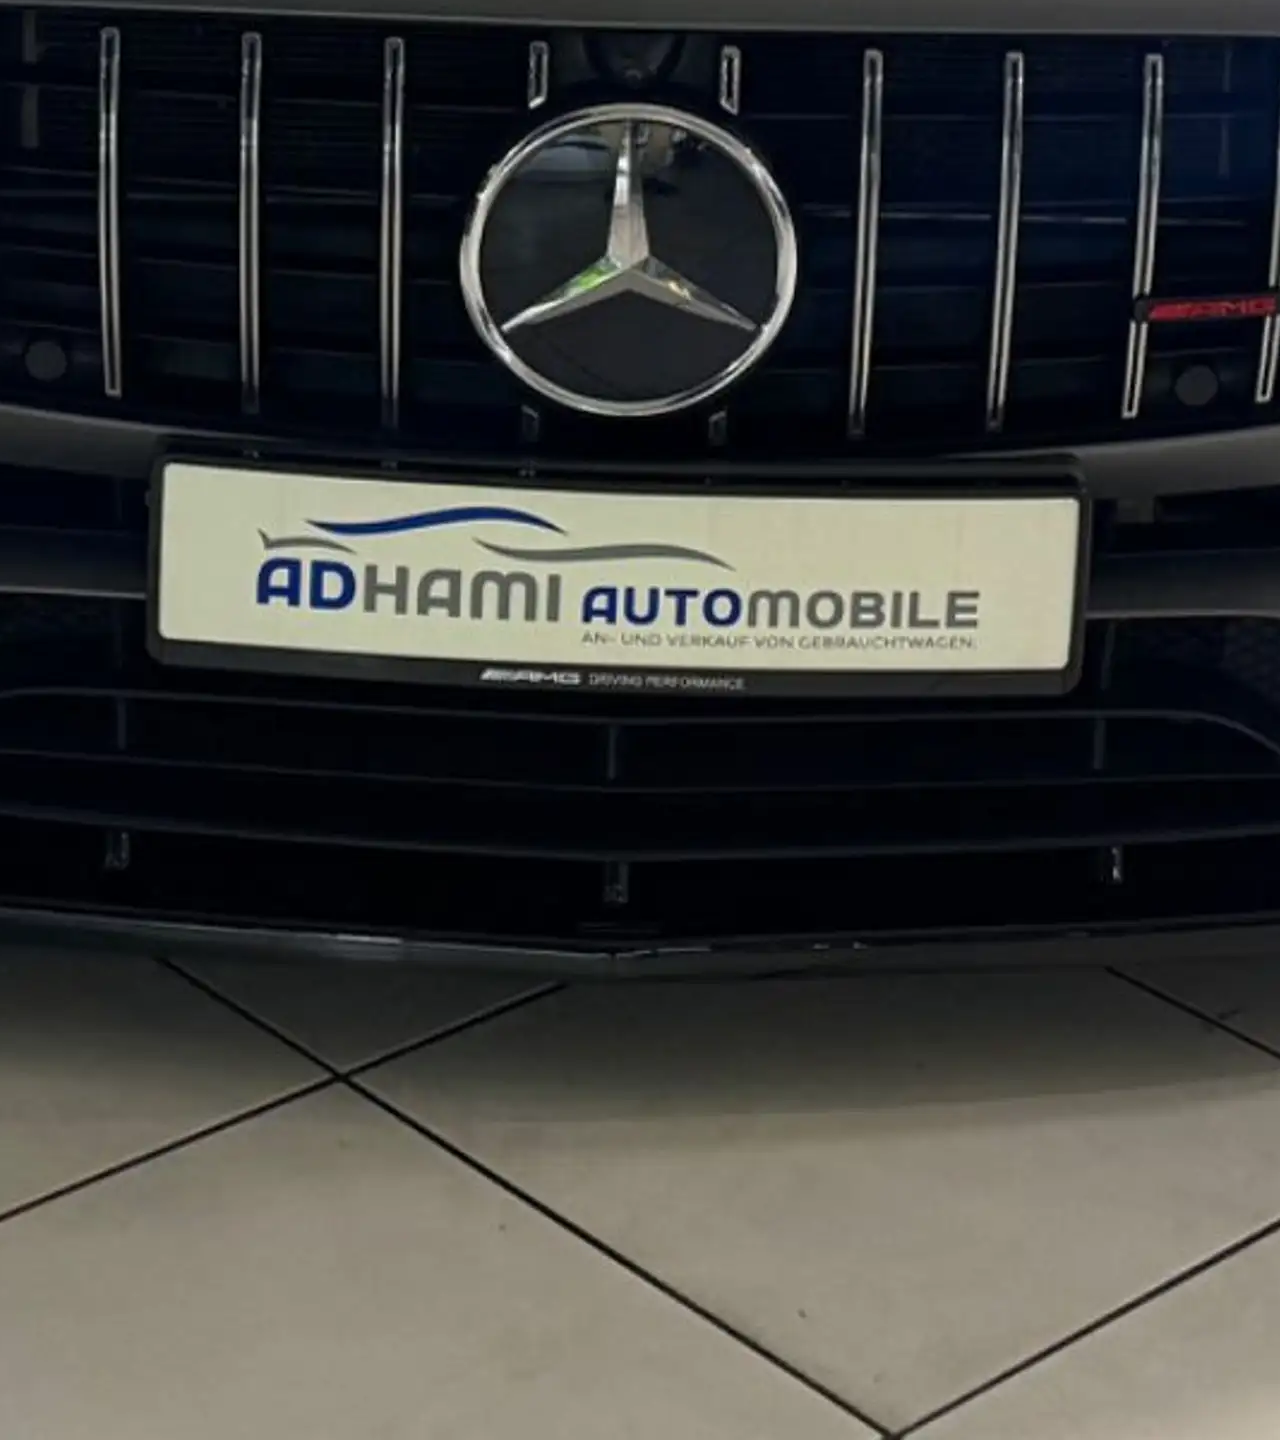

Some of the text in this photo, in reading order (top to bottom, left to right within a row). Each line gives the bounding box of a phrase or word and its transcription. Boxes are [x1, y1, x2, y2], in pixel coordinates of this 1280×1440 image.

[256, 556, 981, 630] ADHAMI AUTOMOBILE
[580, 632, 616, 645] AN-
[621, 634, 662, 647] UND
[666, 634, 752, 648] VERKAUF
[754, 635, 796, 649] VON
